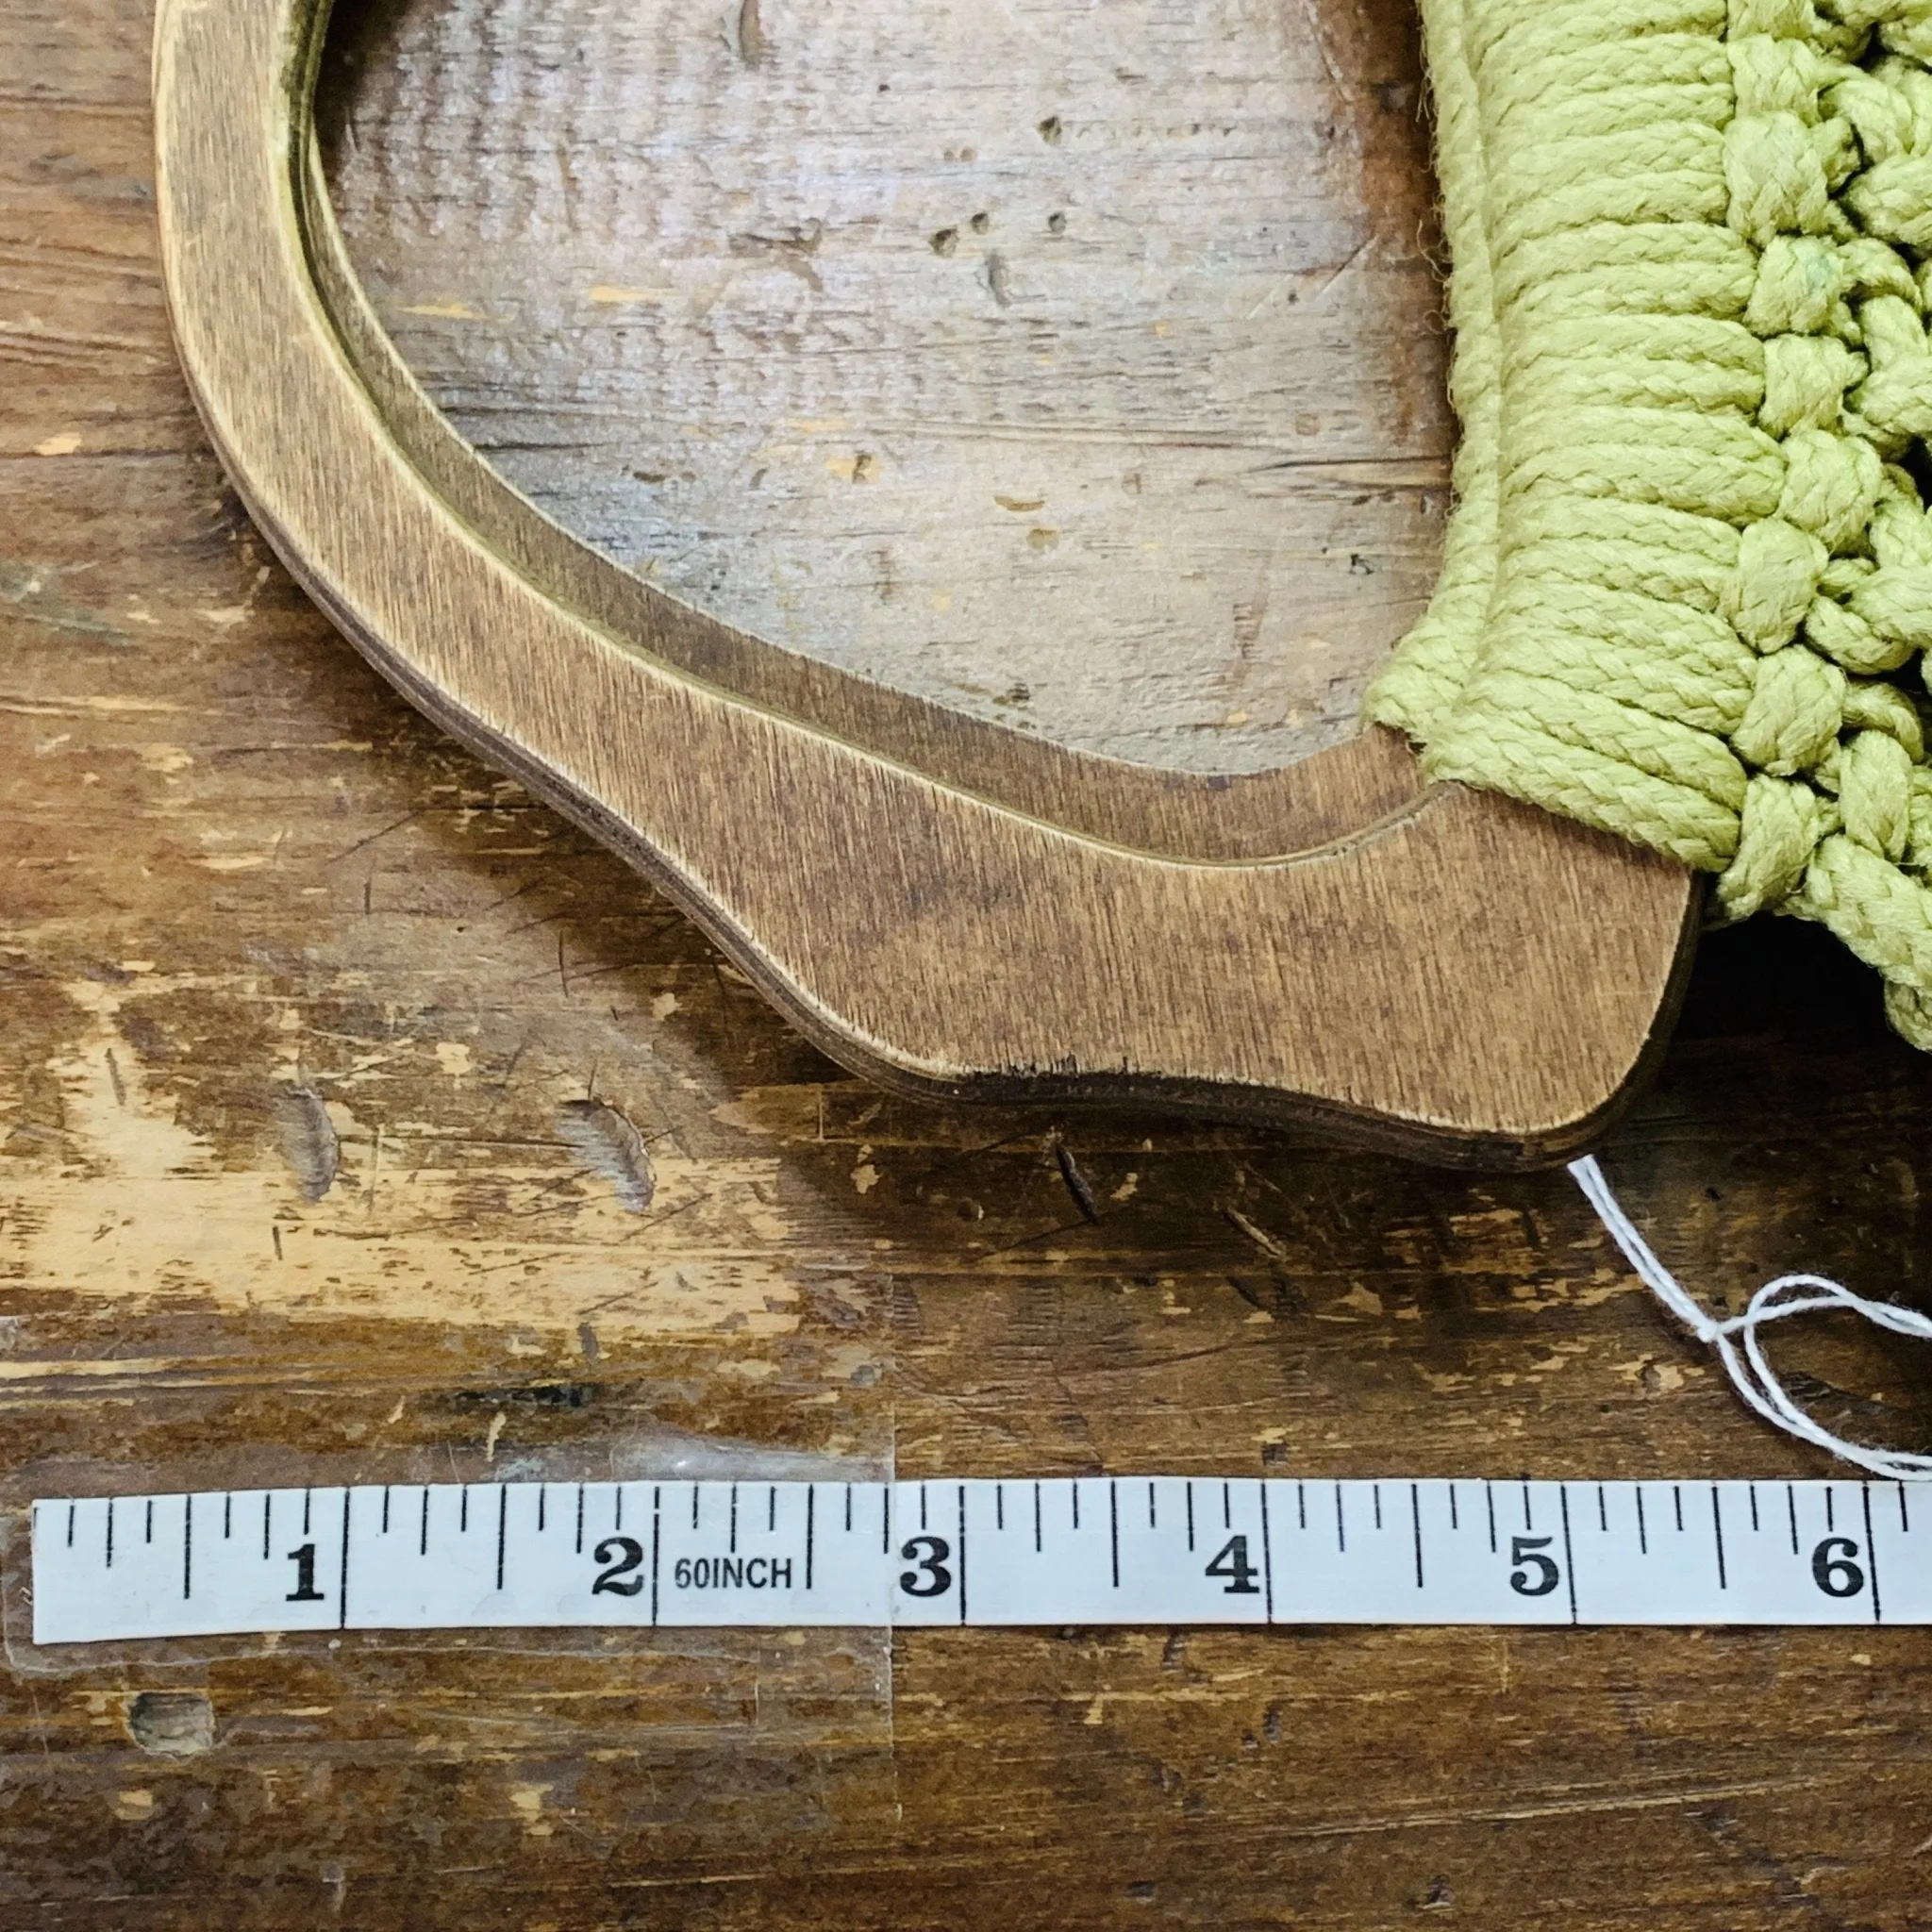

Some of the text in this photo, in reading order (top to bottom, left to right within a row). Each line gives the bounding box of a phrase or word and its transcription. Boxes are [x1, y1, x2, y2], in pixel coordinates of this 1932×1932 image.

[285, 1535, 1866, 1602] 1 2 60INCH 3 4 5 6
